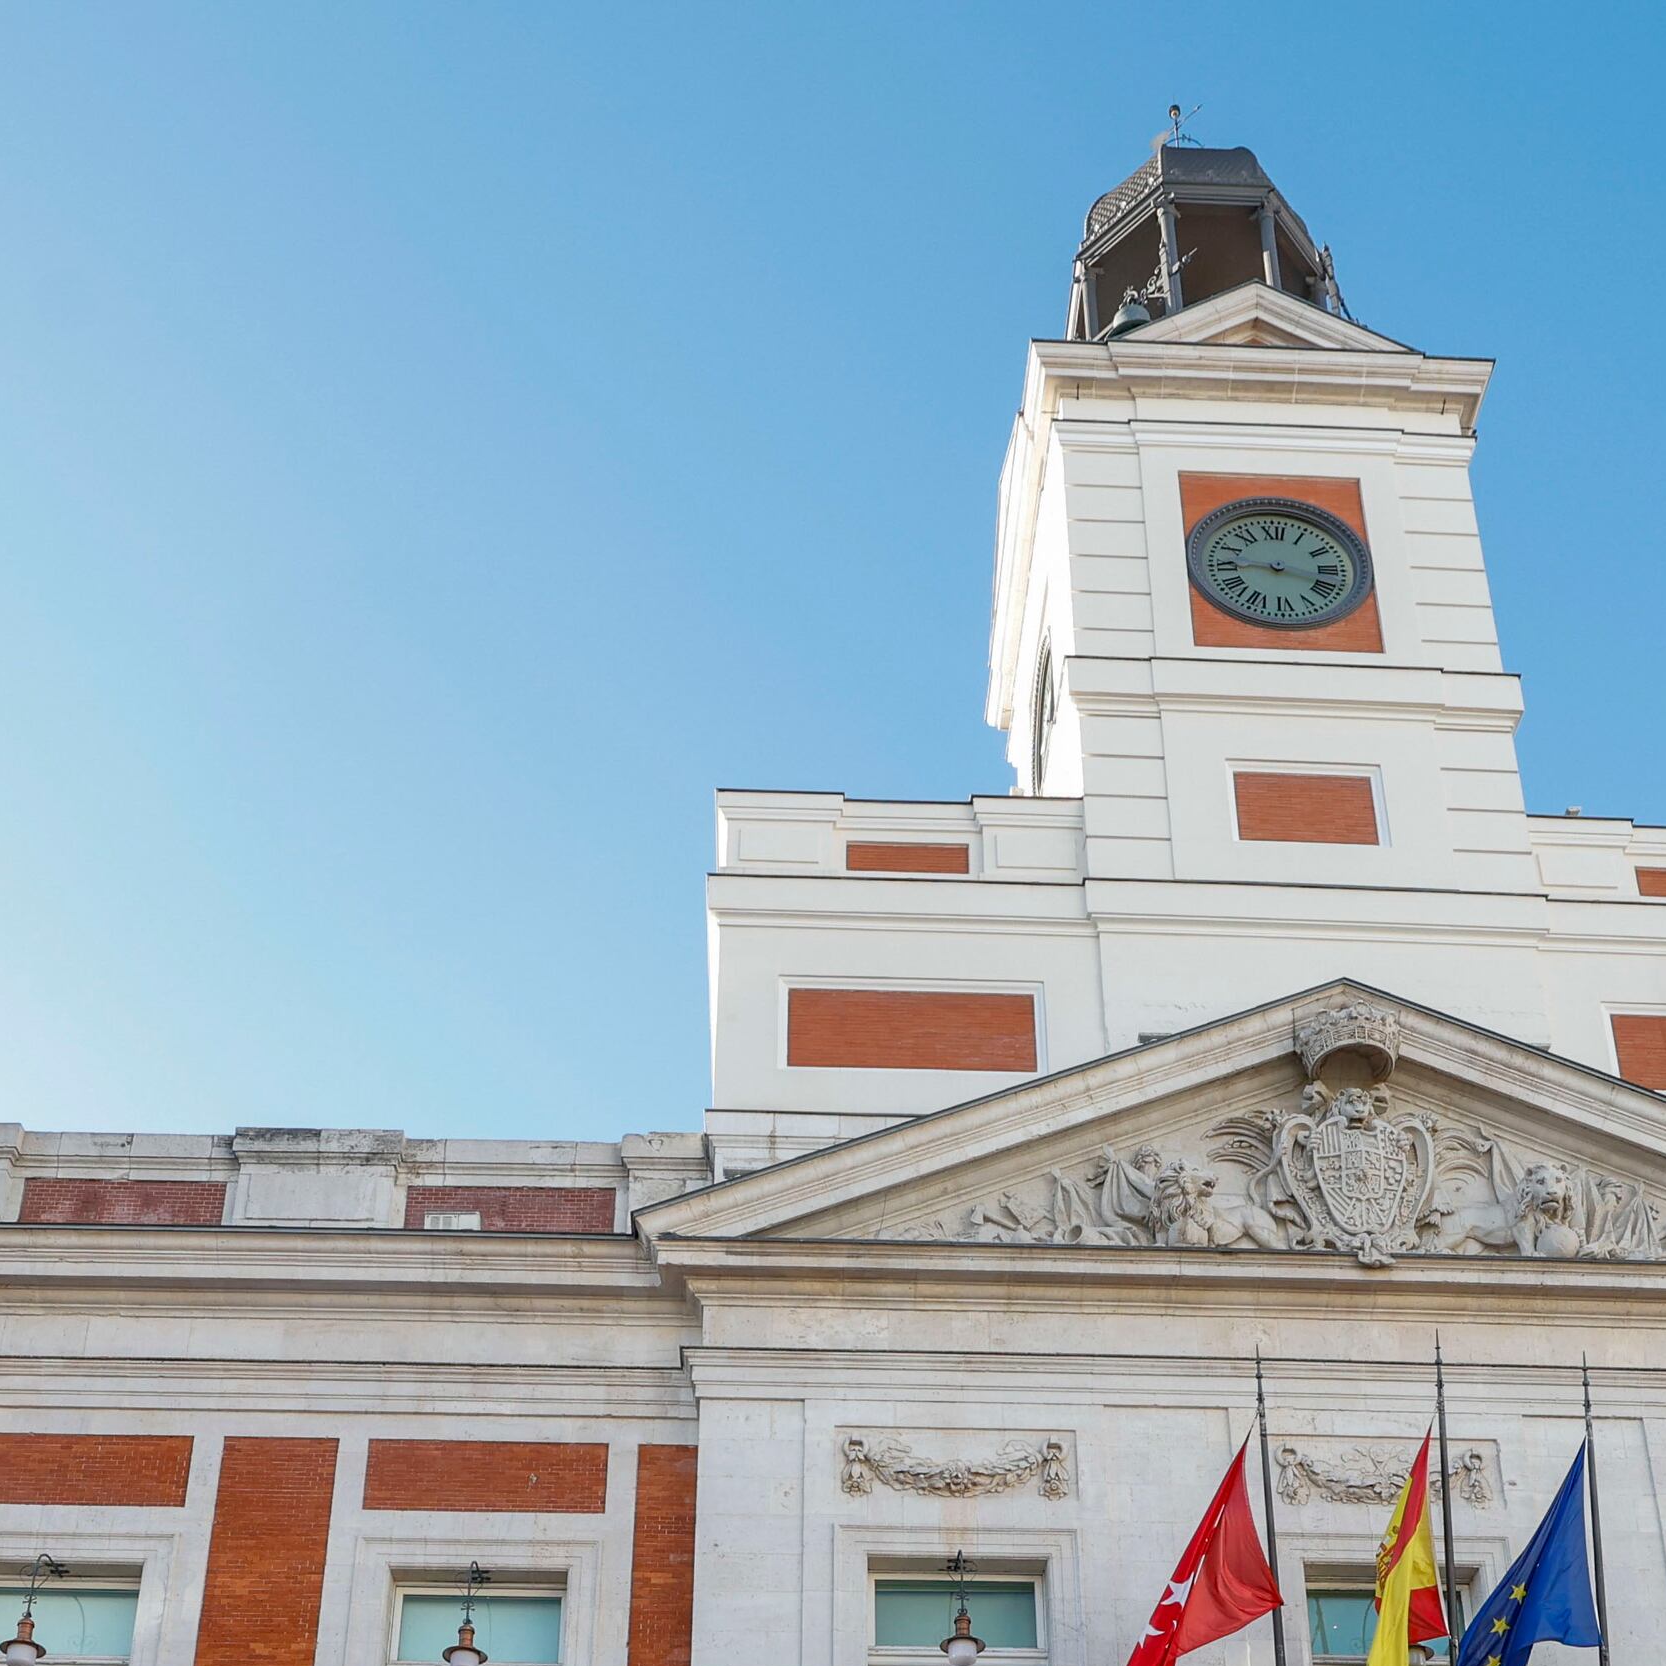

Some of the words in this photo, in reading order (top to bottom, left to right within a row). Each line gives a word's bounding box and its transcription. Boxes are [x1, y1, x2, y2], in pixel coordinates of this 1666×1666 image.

[1234, 528, 1258, 547] XI
[1261, 526, 1286, 541] XII
[1293, 532, 1304, 545] I
[1220, 542, 1243, 556] X
[1309, 546, 1329, 558] II
[1317, 564, 1339, 576] III
[1222, 575, 1249, 598] VIII
[1309, 579, 1336, 599] IIII
[1245, 590, 1266, 609] VII
[1277, 596, 1295, 612] VI
[1299, 593, 1315, 609] V
